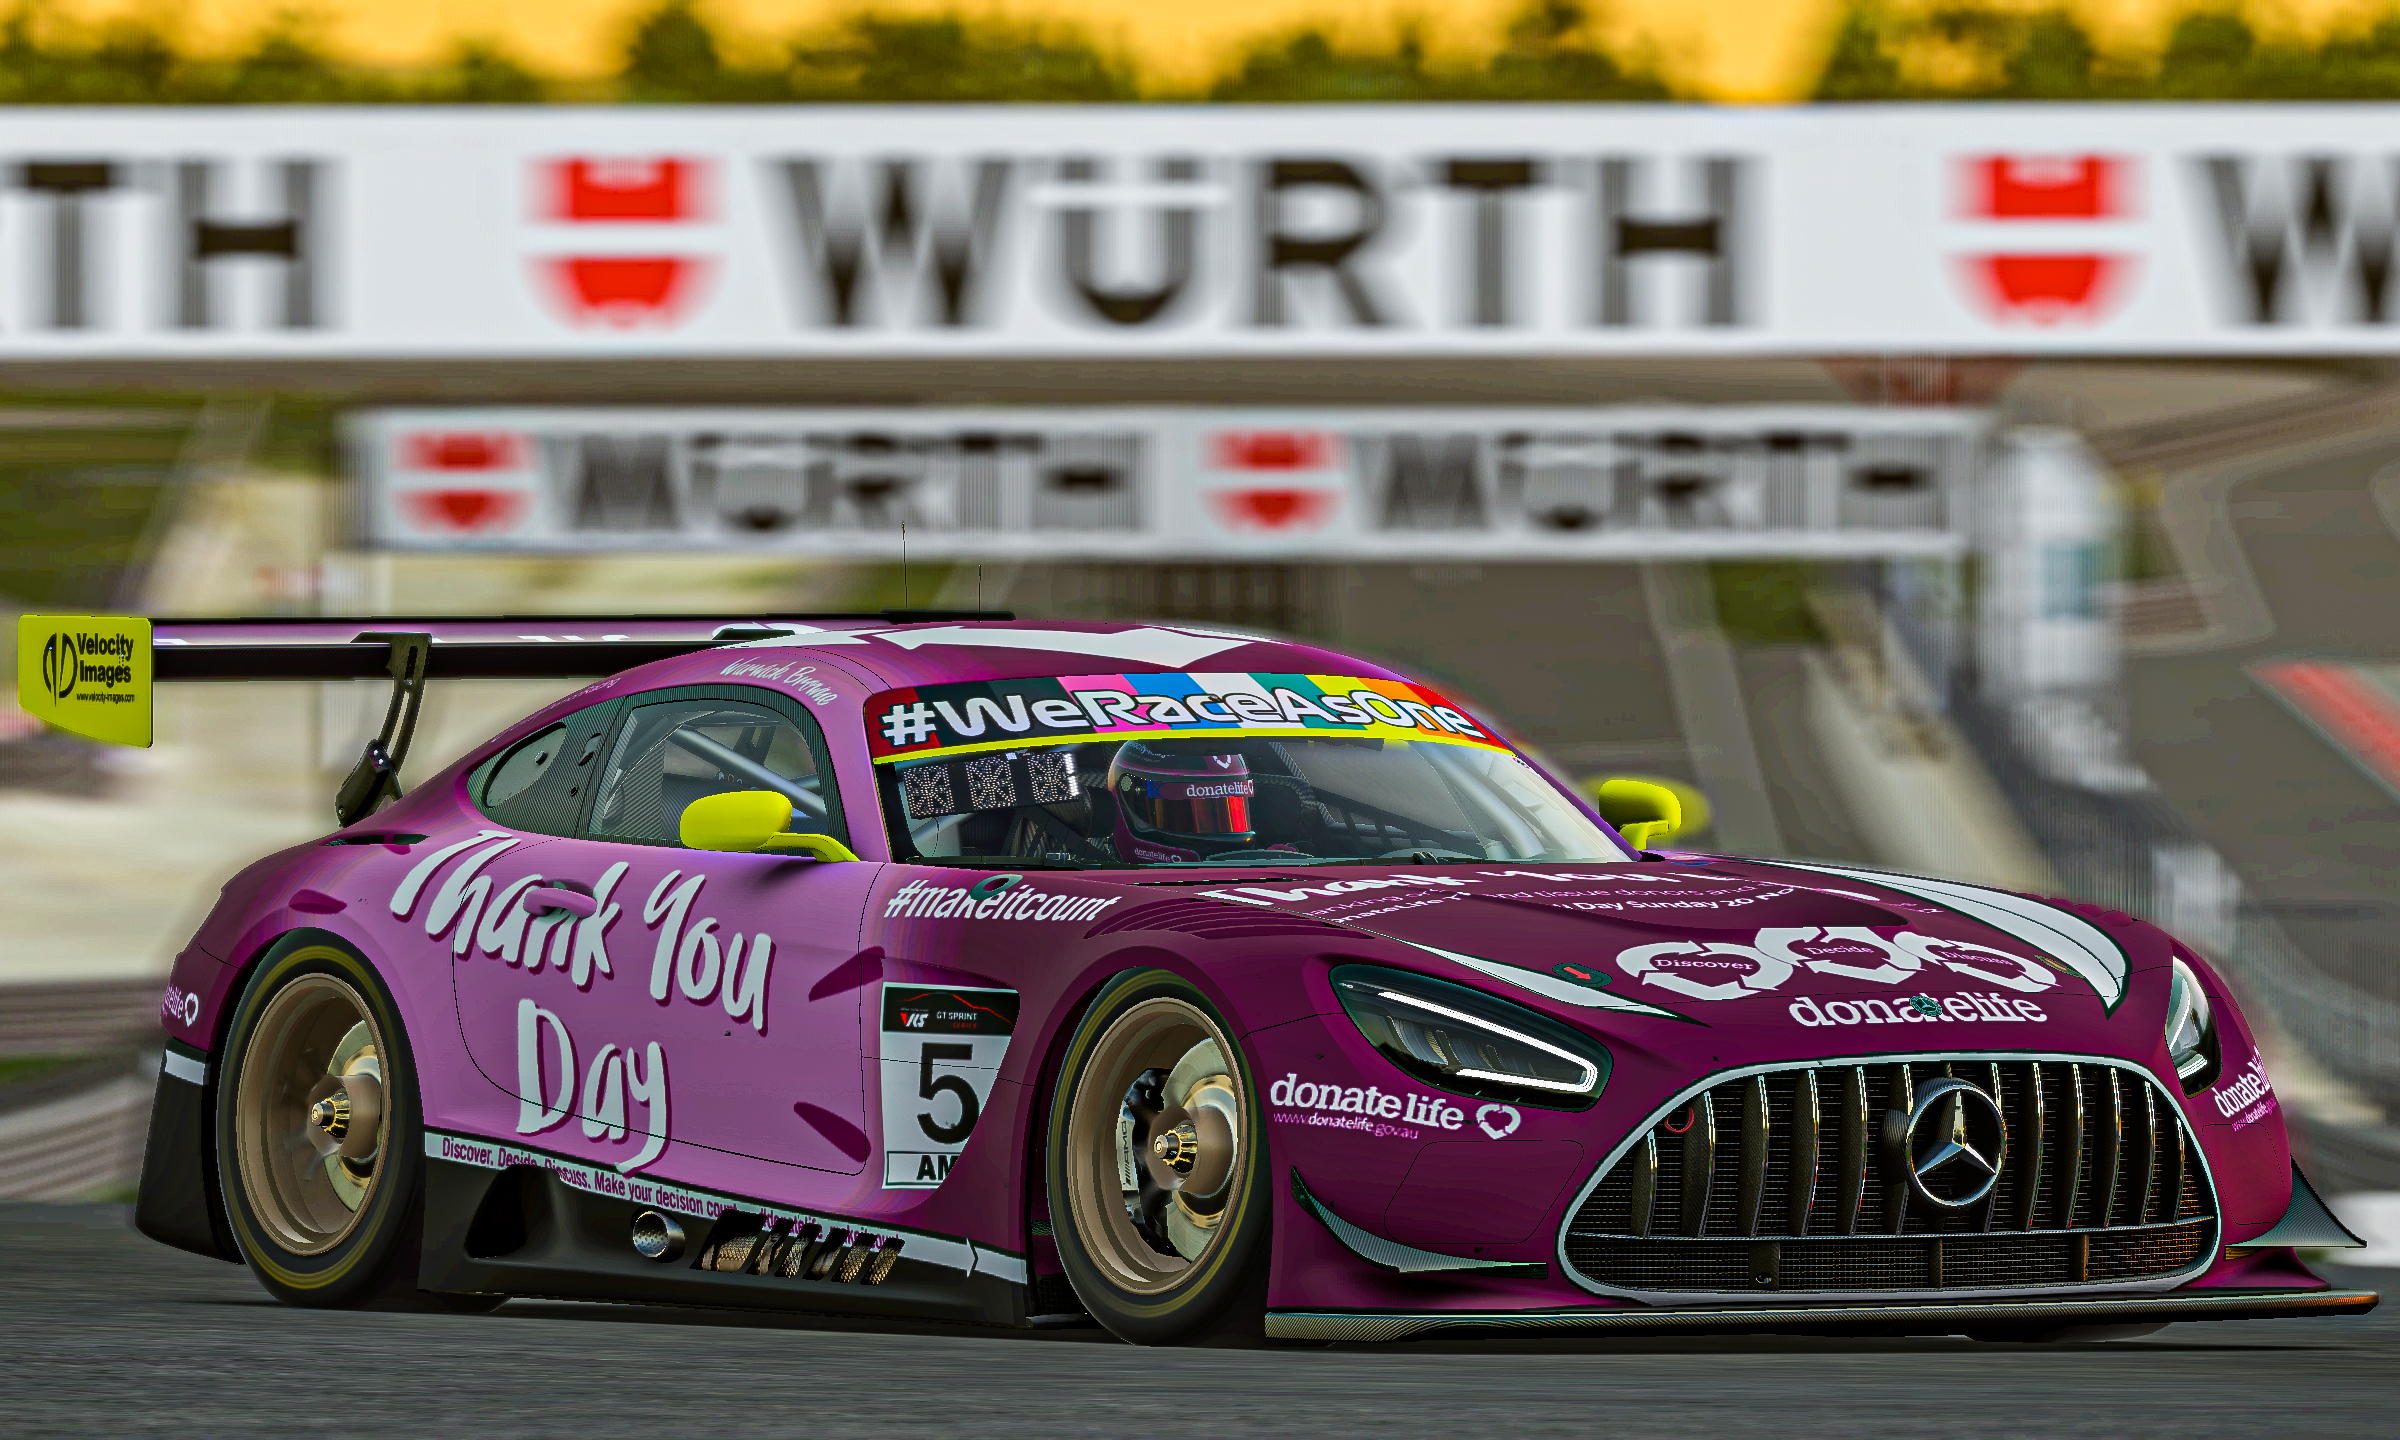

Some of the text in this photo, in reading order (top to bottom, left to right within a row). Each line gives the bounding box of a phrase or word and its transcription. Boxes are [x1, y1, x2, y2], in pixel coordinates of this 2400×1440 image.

[765, 156, 1760, 328] WÜRTH
[76, 632, 134, 662] Velocity
[79, 659, 132, 689] Images
[719, 656, 797, 680] Warwick
[884, 687, 1486, 746] #WeRaceAsOne
[1186, 781, 1249, 797] donatelife
[1572, 902, 1624, 911] Day
[1625, 900, 1719, 909] Sunday
[1719, 897, 1754, 907] 20
[1614, 888, 1704, 896] donors
[390, 829, 773, 1034] Thank You
[1654, 958, 1754, 970] Discover
[936, 1011, 978, 1021] GT SPRINT
[516, 998, 670, 1176] Day
[917, 1041, 980, 1145] 5
[442, 1136, 494, 1167] Discover.
[594, 1169, 626, 1197] Make
[628, 1180, 653, 1203] your
[655, 1184, 704, 1215] decision
